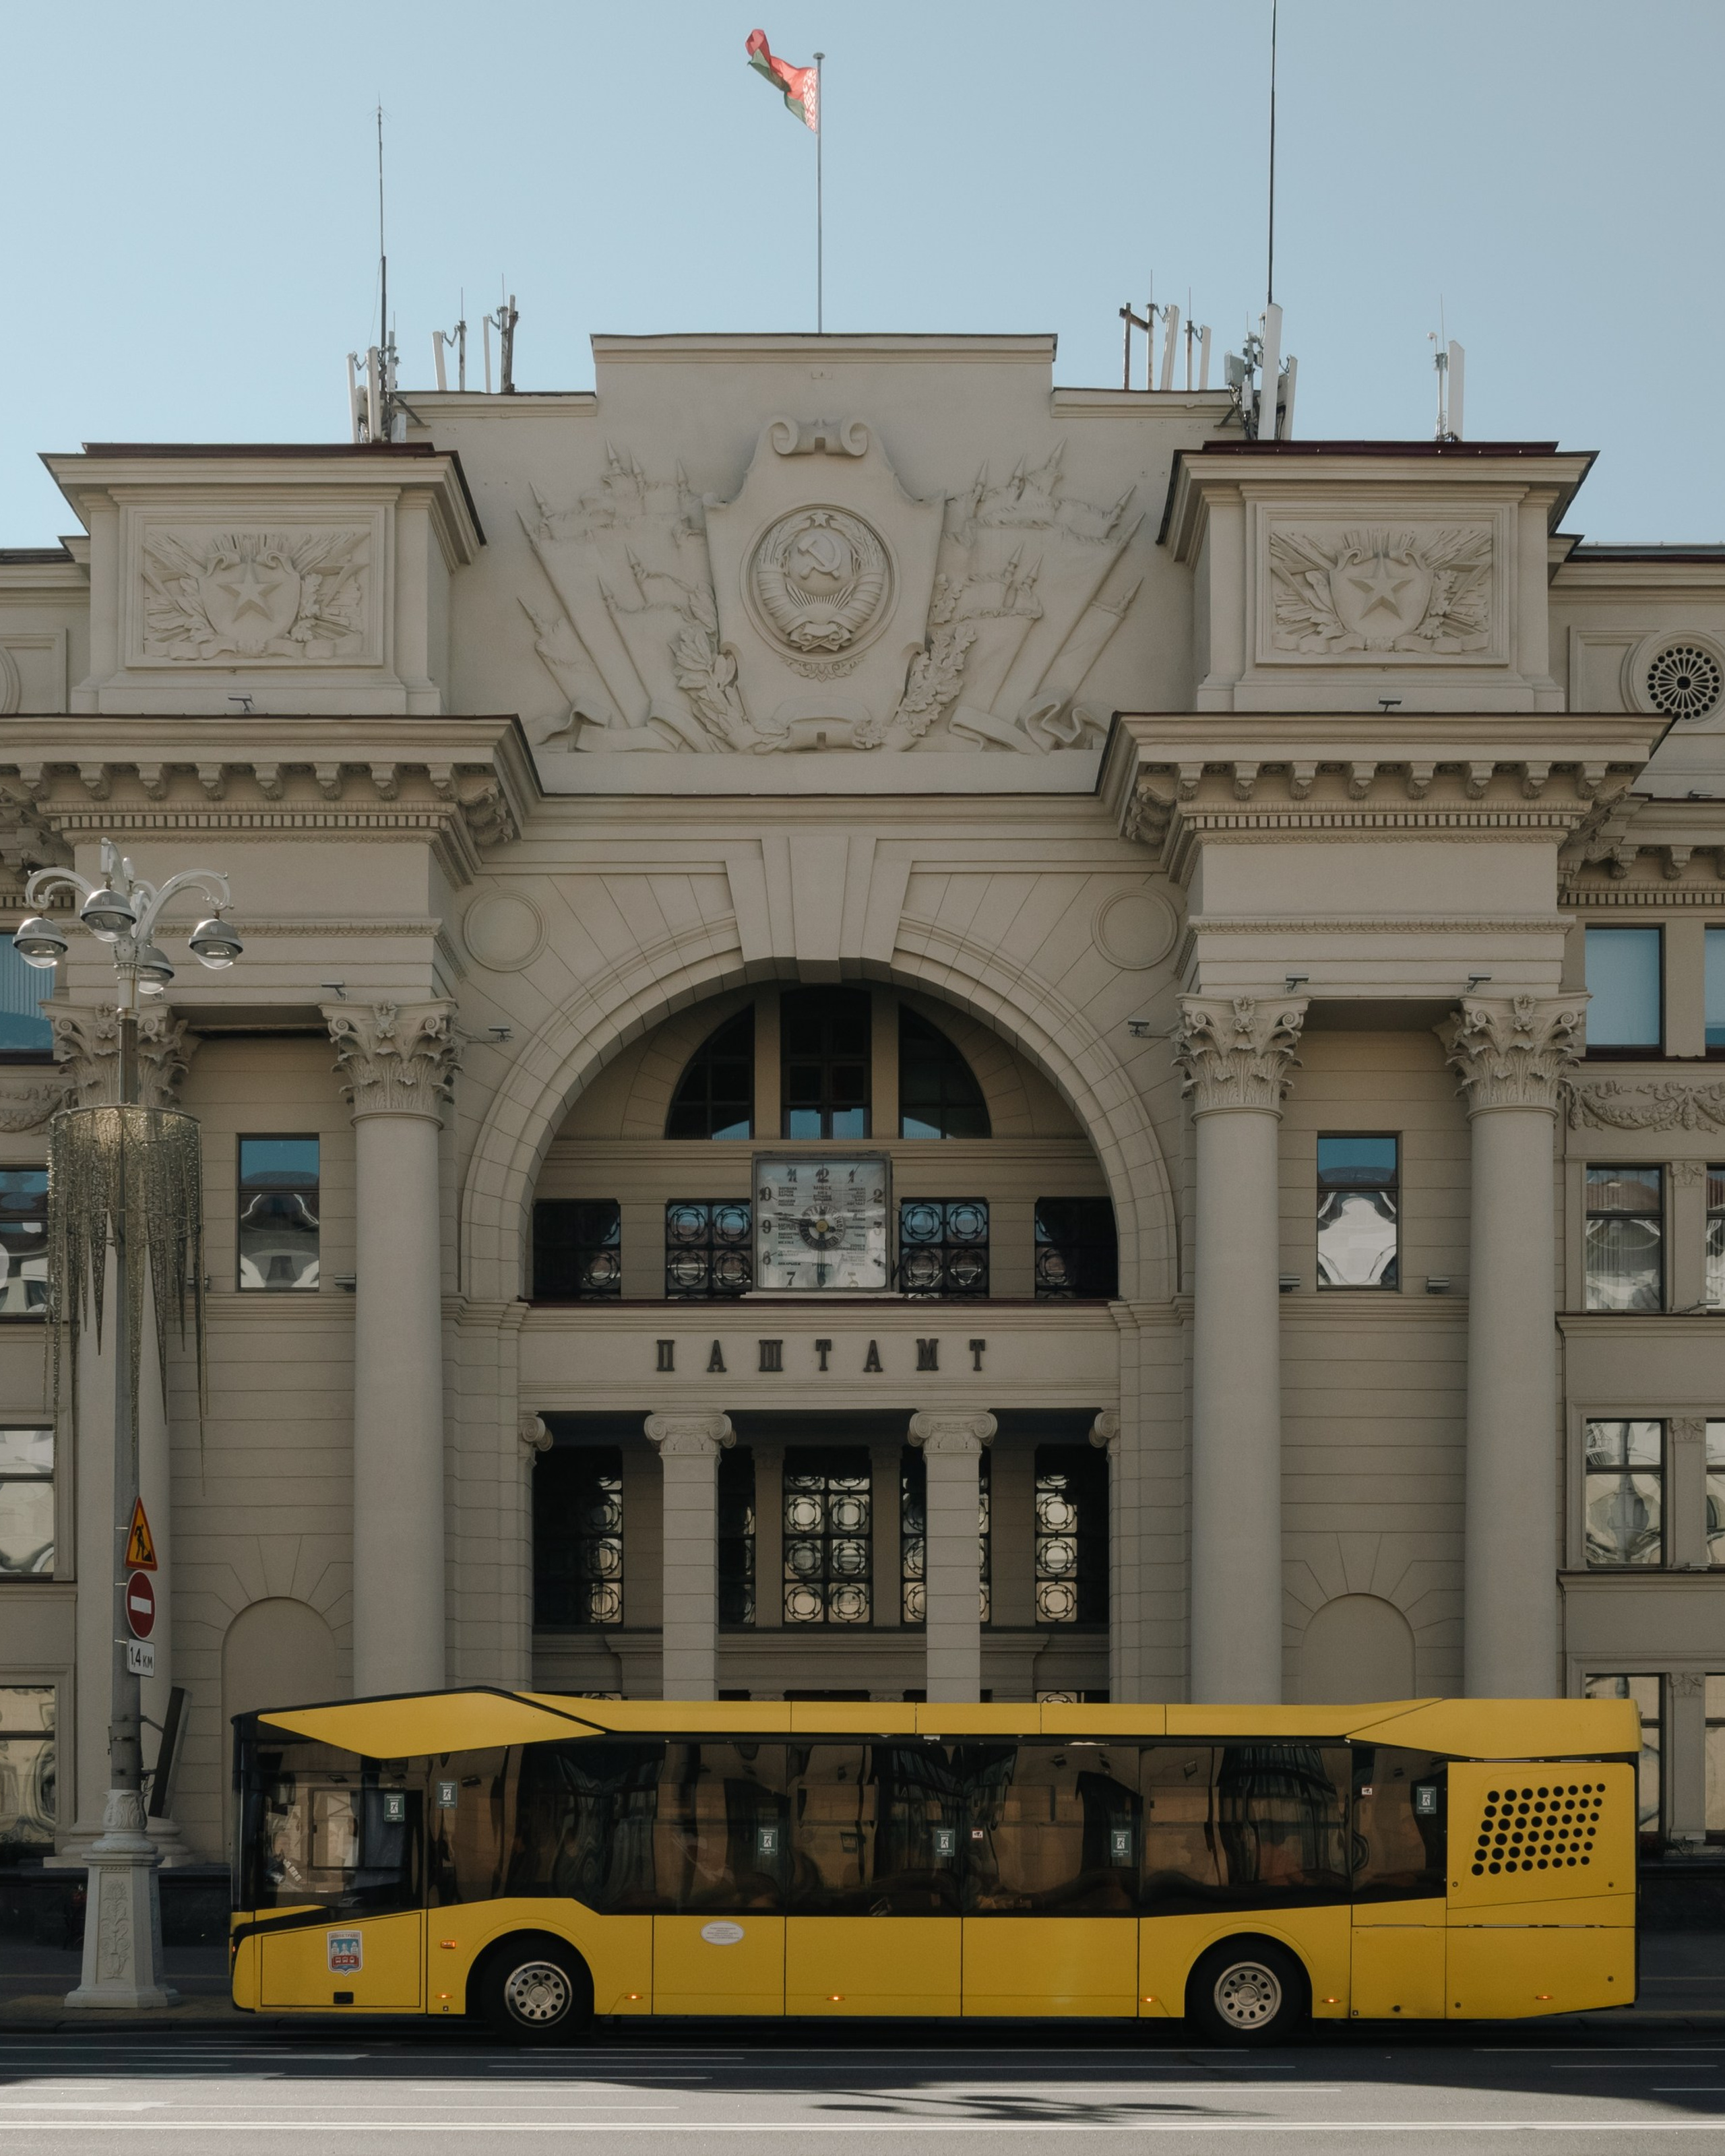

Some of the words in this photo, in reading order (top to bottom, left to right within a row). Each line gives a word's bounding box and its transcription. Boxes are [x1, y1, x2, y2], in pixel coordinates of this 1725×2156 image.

[815, 1168, 829, 1183] 12
[759, 1186, 772, 1201] 10
[873, 1188, 883, 1203] 2
[763, 1219, 772, 1234] 9
[786, 1271, 796, 1286] 7
[656, 1339, 986, 1372] ПАШТАМТ
[130, 1647, 141, 1668] 1,4
